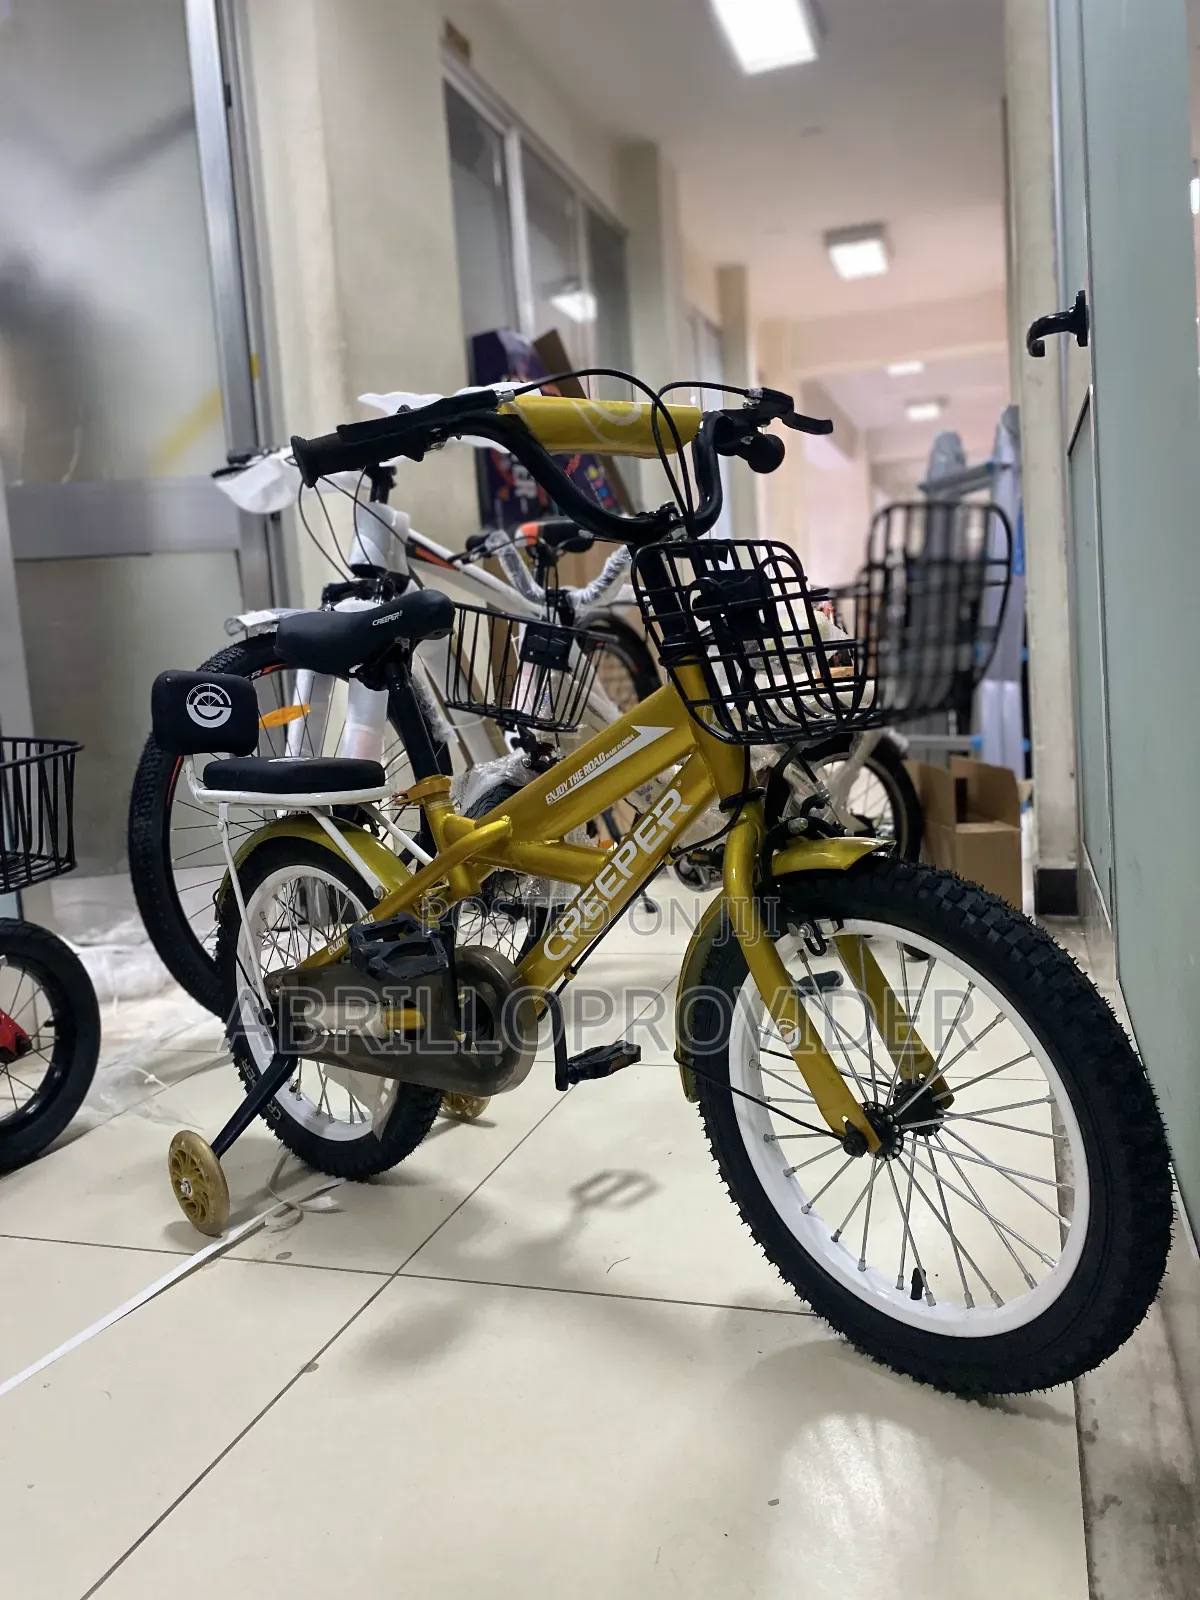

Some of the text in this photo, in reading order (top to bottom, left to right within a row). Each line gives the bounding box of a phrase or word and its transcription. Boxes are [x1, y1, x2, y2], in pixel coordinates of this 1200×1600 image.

[372, 611, 400, 626] CREEPER
[545, 779, 569, 805] ENJOY
[568, 768, 584, 787] THE
[583, 751, 606, 776] ROAD
[543, 788, 693, 961] CREEPER
[328, 936, 347, 955] ENJOY
